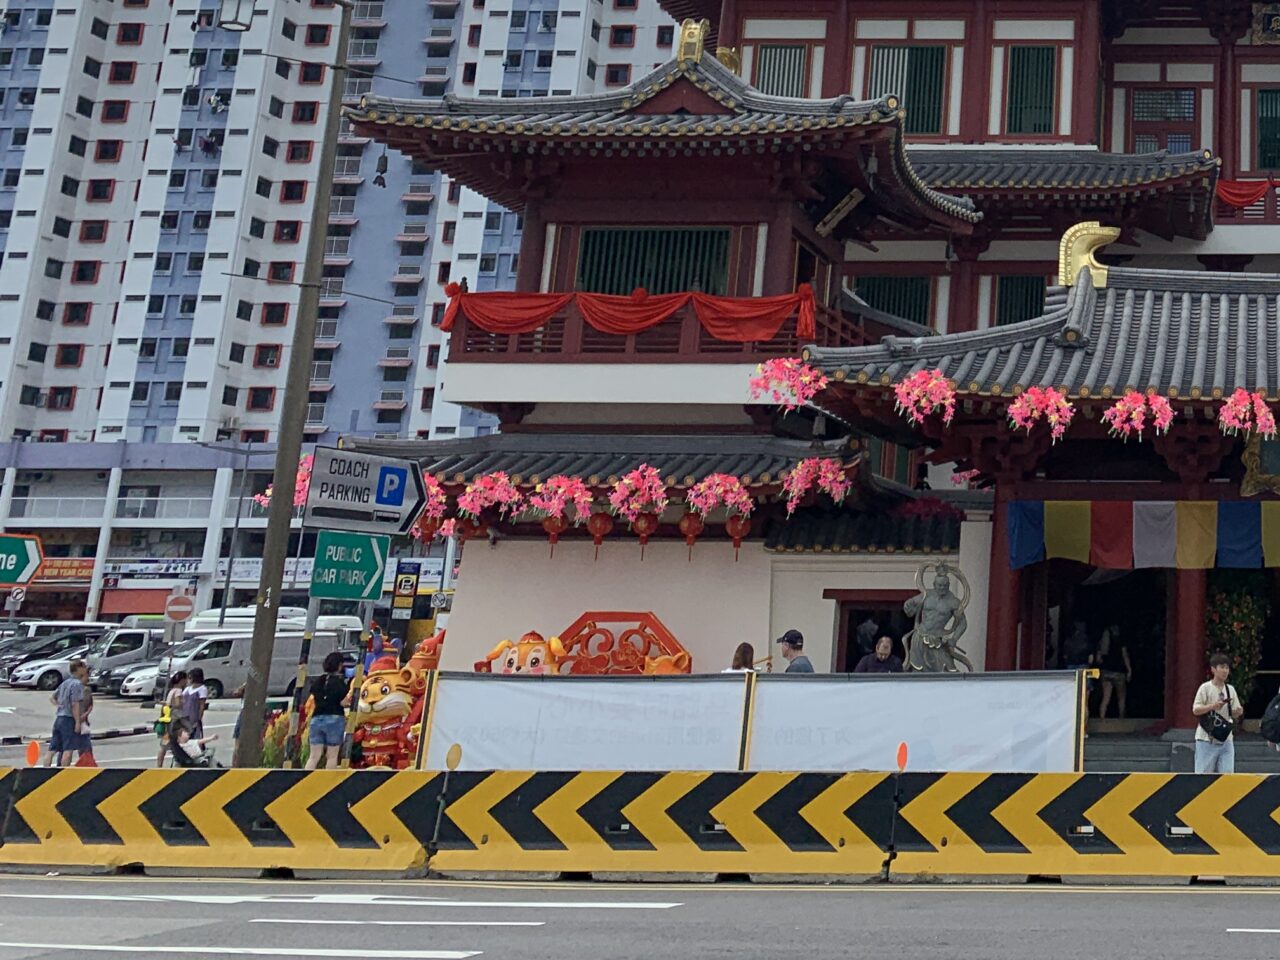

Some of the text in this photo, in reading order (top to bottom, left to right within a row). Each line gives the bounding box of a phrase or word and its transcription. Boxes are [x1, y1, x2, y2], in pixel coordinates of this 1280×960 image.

[329, 457, 370, 479] COACH
[319, 482, 371, 504] PARKING
[382, 473, 400, 498] P
[325, 545, 362, 563] PUBLIC
[314, 567, 366, 586] CAR PARK
